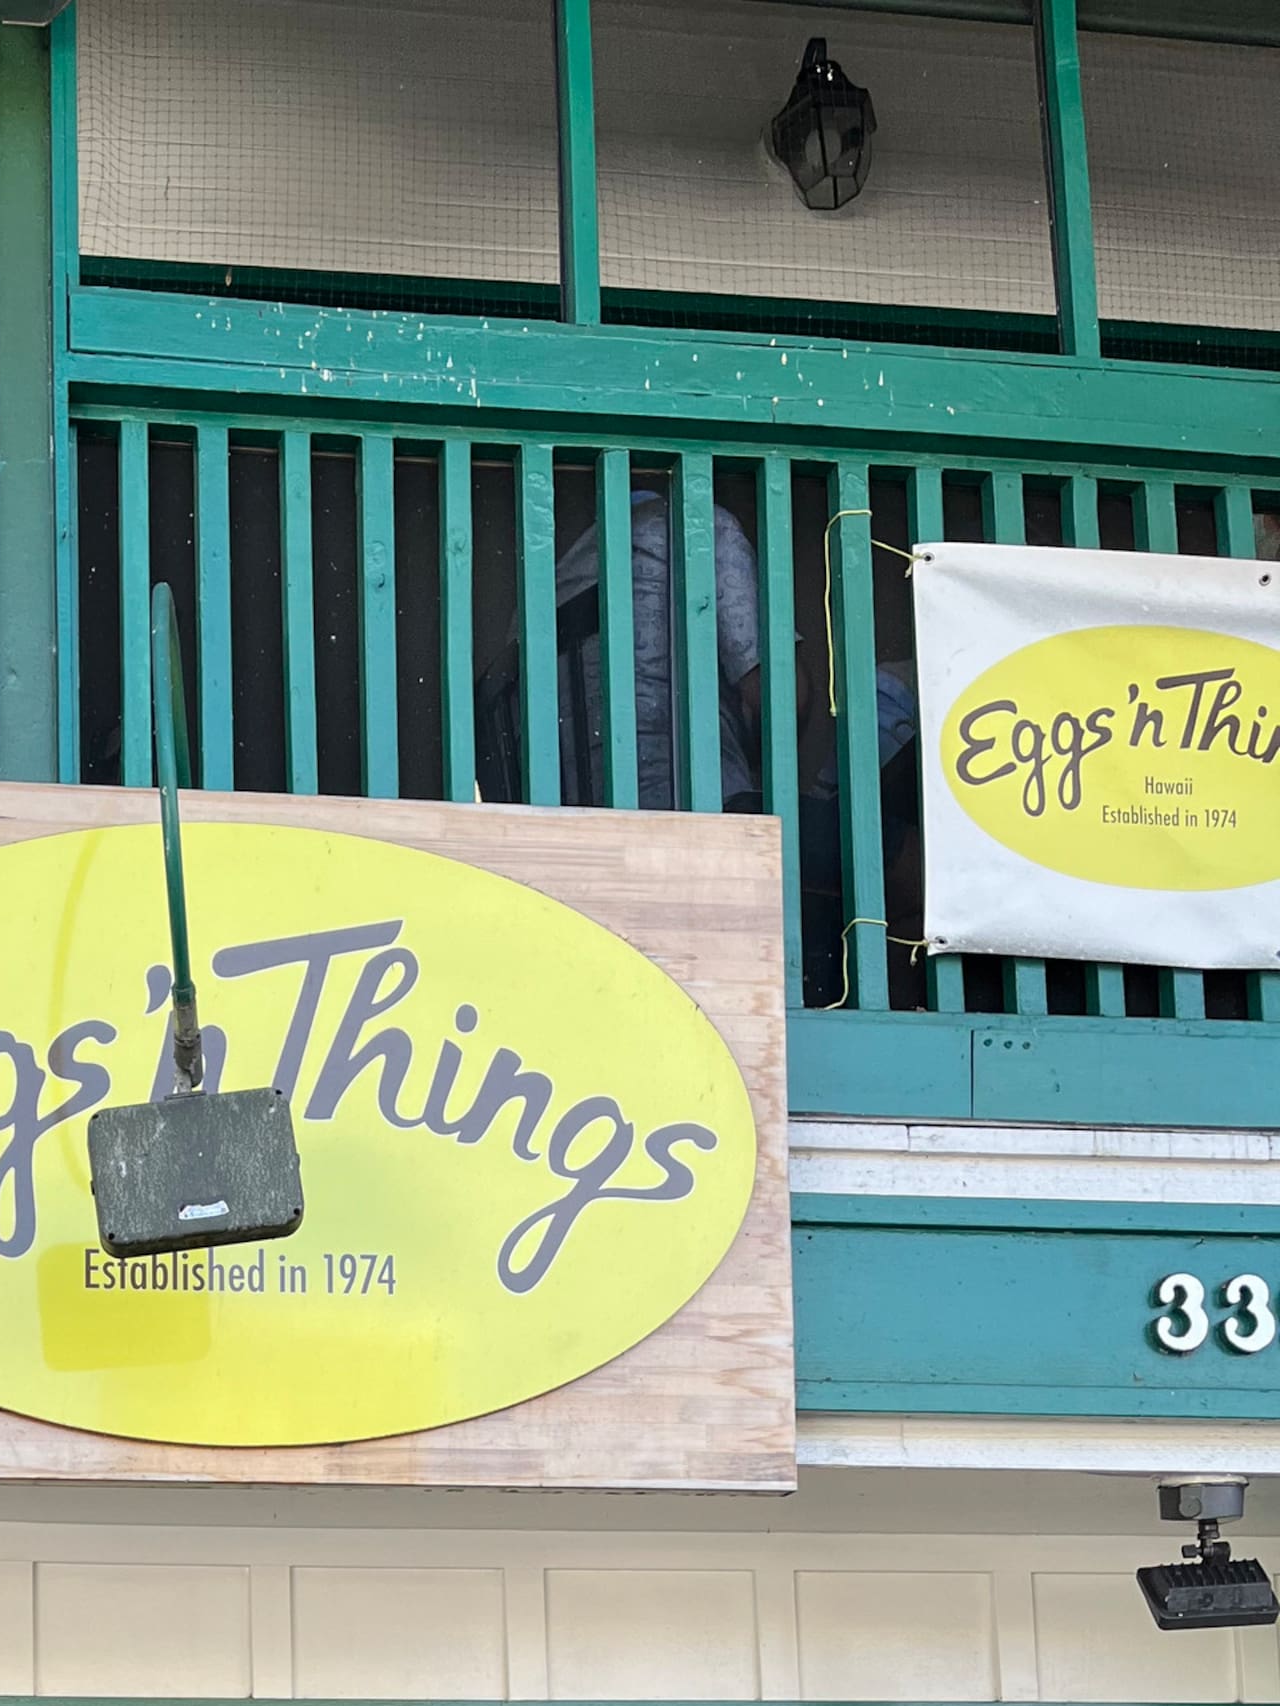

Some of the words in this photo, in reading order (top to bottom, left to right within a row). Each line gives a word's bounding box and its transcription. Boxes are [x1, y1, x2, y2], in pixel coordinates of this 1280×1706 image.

[955, 699, 1116, 817] Eggs
[1144, 775, 1193, 796] Hawaii
[1102, 805, 1180, 828] Established
[1184, 807, 1198, 828] in
[1204, 809, 1238, 829] 1974
[212, 918, 719, 1294] Things
[84, 1246, 265, 1293] Established
[278, 1254, 307, 1294] in
[323, 1253, 397, 1295] 1974
